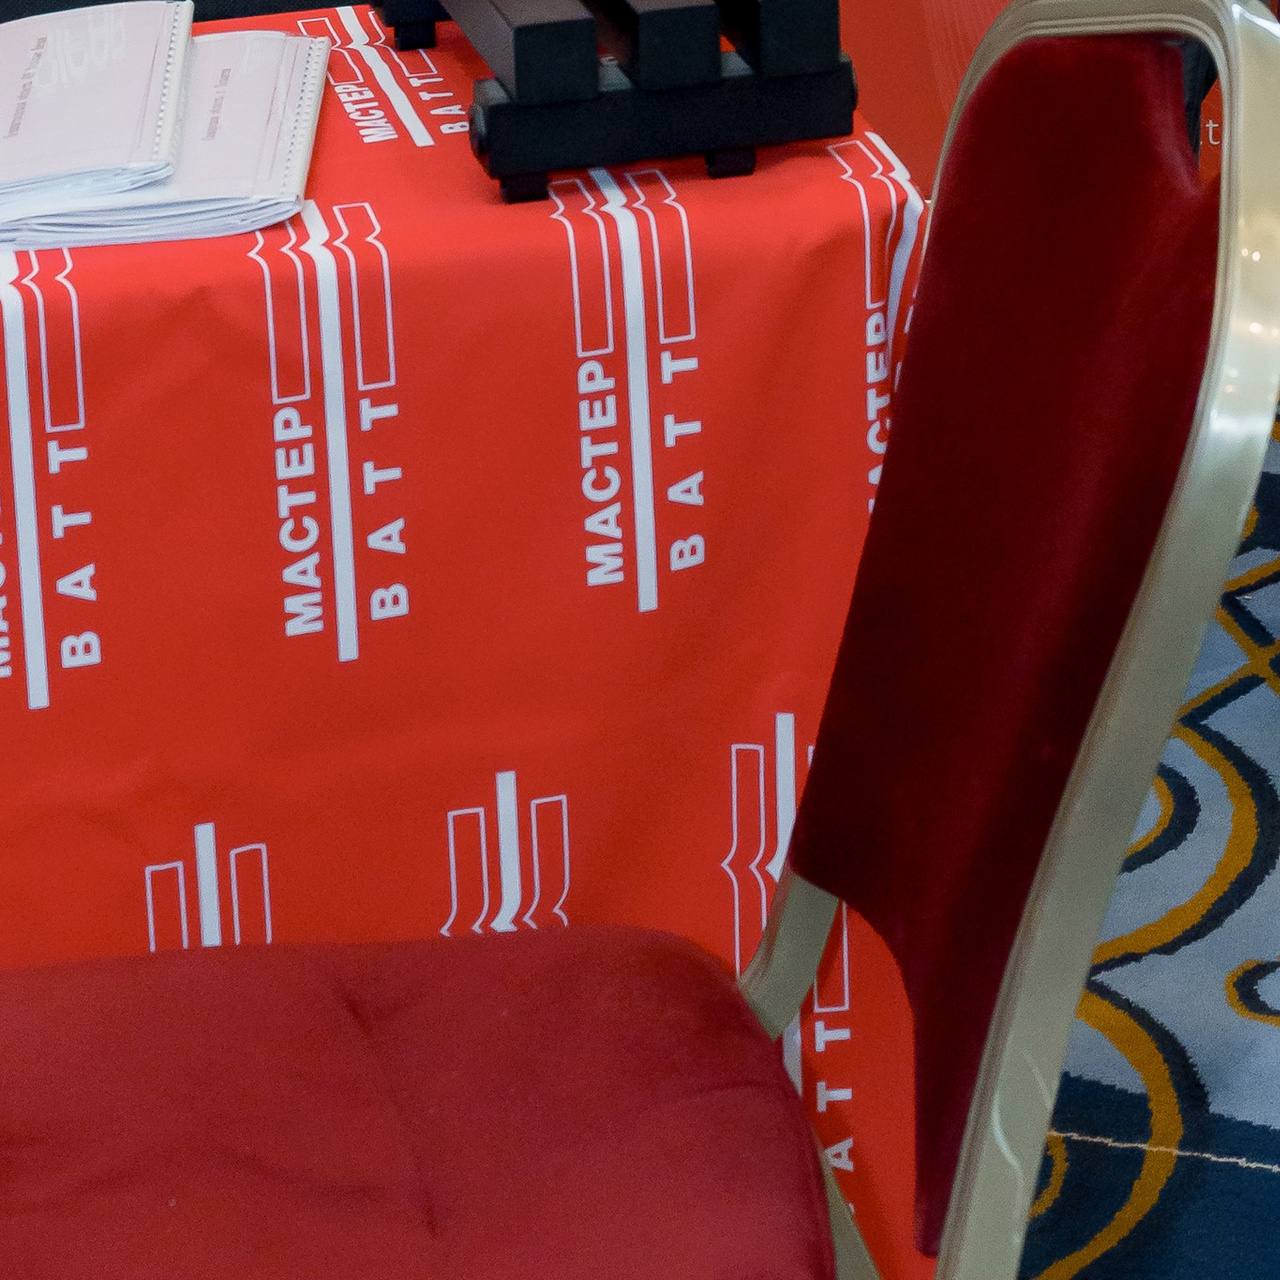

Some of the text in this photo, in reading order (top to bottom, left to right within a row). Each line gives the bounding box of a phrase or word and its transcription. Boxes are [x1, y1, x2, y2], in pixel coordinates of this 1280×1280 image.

[334, 84, 398, 143] МАСТЕР
[47, 440, 102, 668] ВАТТ
[274, 405, 325, 637] МАСТЕР
[358, 398, 411, 621] ВАТТ
[577, 359, 625, 587] МАСТЕР
[660, 351, 706, 572] ВАТТ
